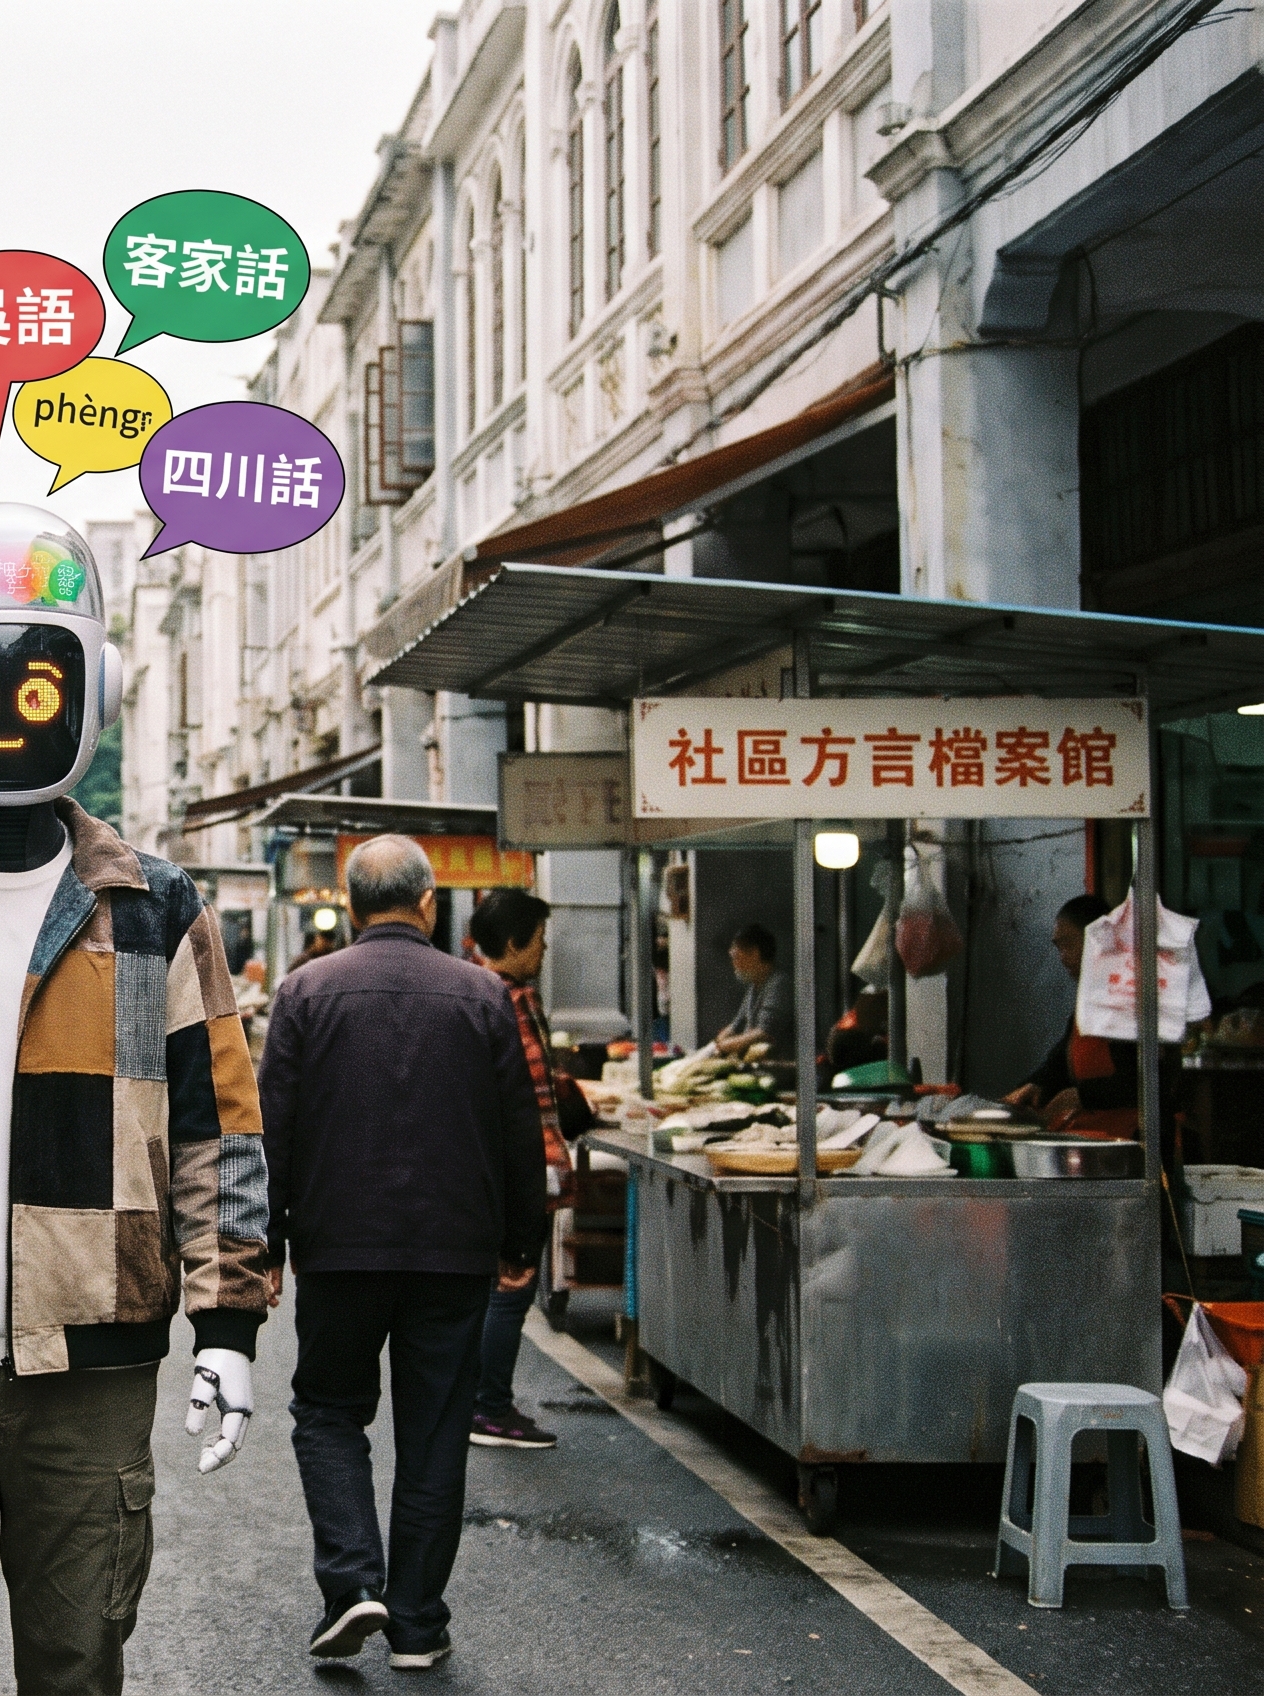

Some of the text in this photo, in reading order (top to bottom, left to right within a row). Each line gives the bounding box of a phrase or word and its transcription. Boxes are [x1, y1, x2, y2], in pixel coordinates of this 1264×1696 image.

[668, 727, 1117, 788] 社區方言檔案館
